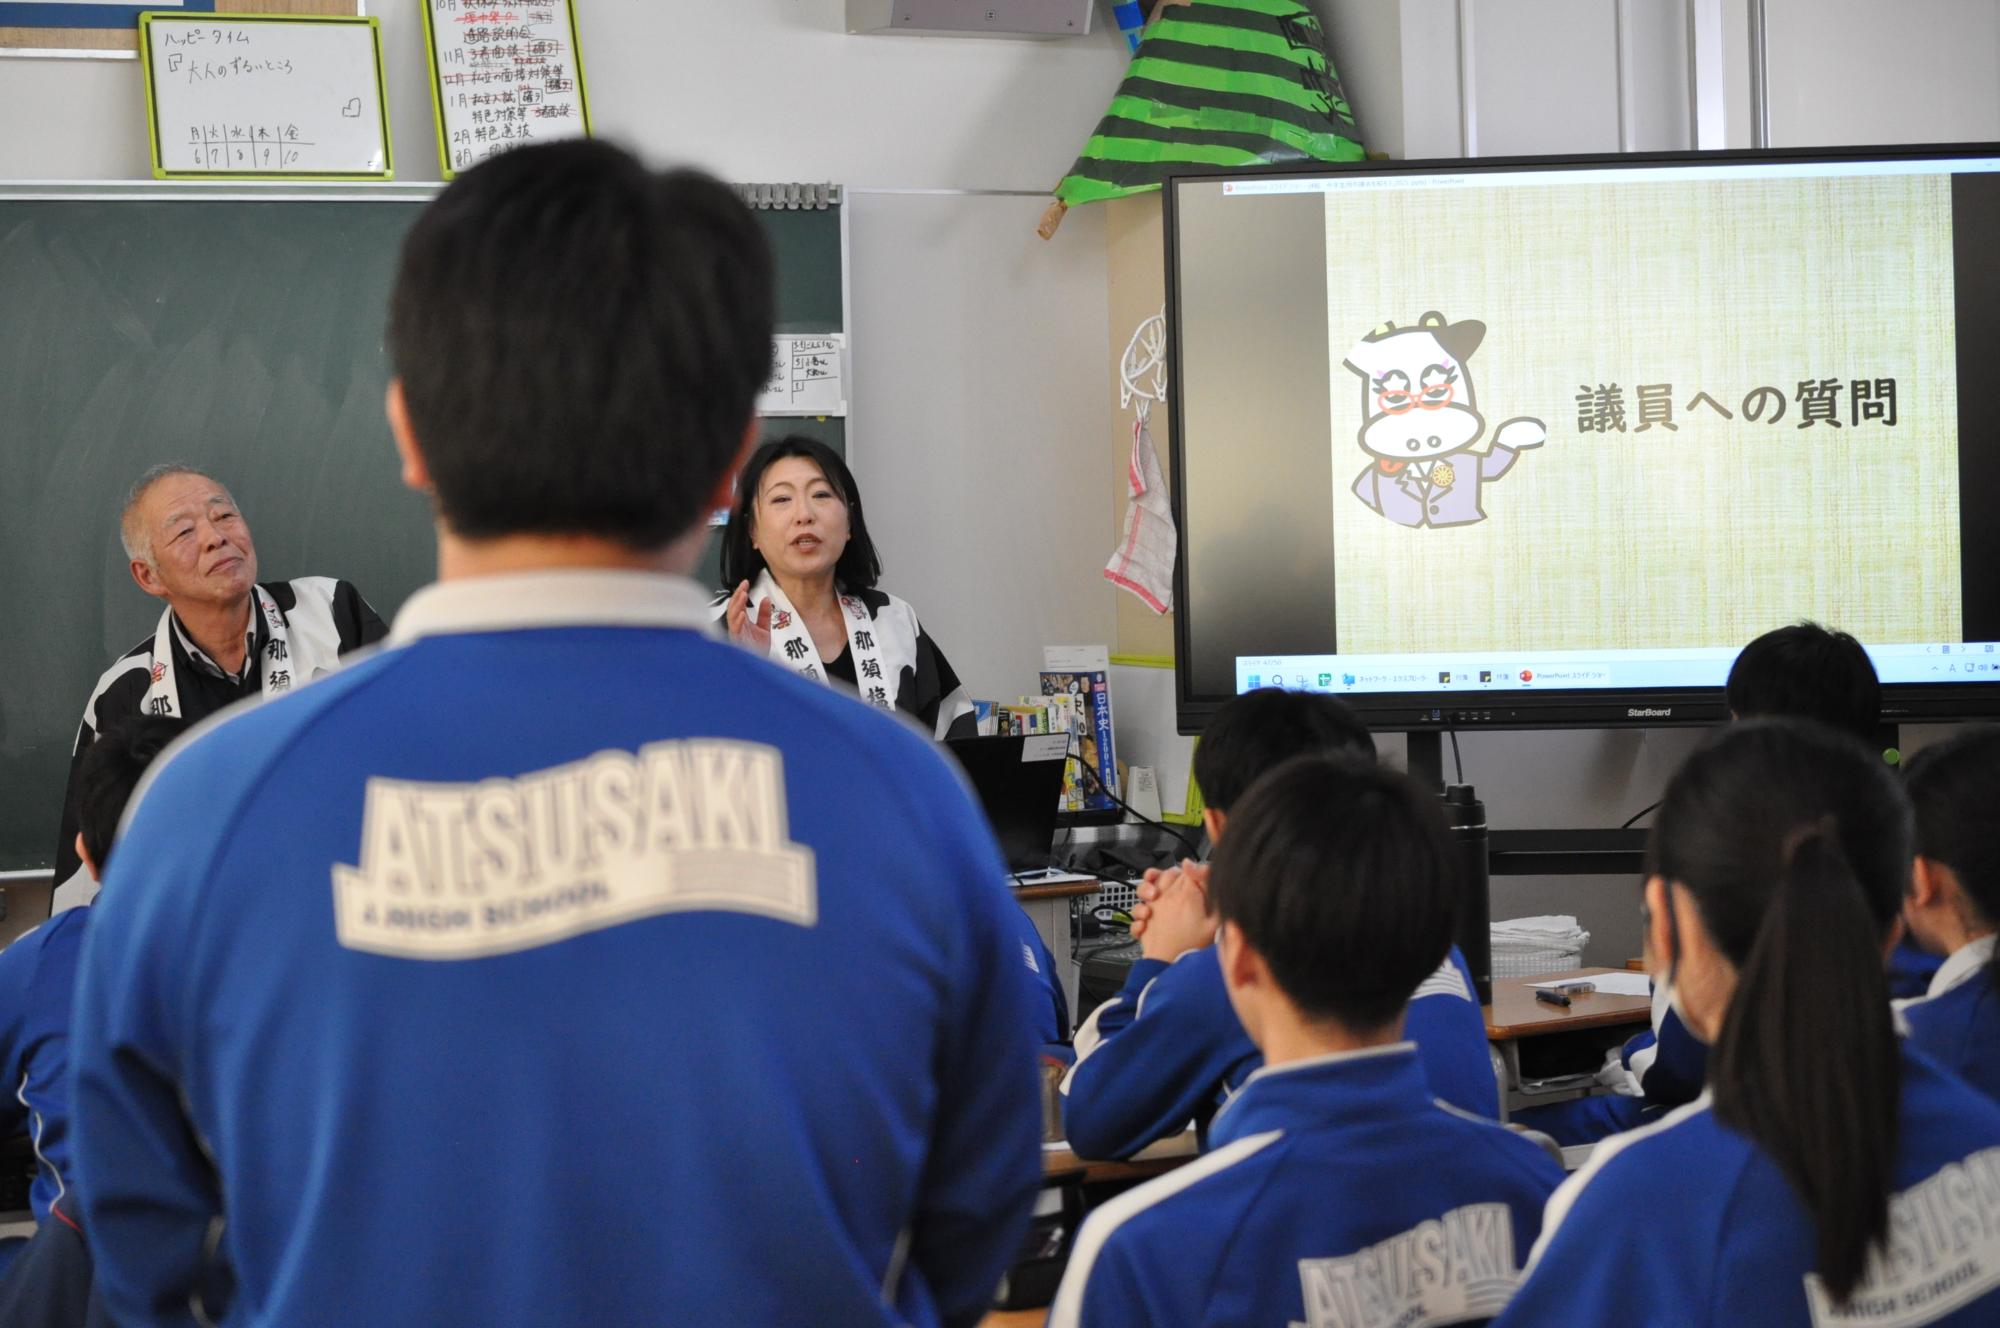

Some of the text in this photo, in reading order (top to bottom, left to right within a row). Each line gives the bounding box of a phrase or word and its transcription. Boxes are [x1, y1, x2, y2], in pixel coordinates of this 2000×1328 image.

[444, 48, 465, 65] 11月
[190, 124, 300, 140] 月 火 水 木 金
[454, 121, 534, 145] 2月 特色選抜
[193, 149, 202, 164] 6
[210, 149, 219, 165] 7
[282, 150, 300, 164] 10
[1575, 377, 1898, 434] 議員への質問
[266, 637, 291, 693] 那須
[1536, 671, 1570, 679] PowerPoint
[1627, 707, 1672, 718] StarBoard
[366, 744, 785, 896] ATSUSAKI
[1302, 1204, 1512, 1328] ATSUSAKI
[1904, 1258, 1981, 1306] SCHOOL
